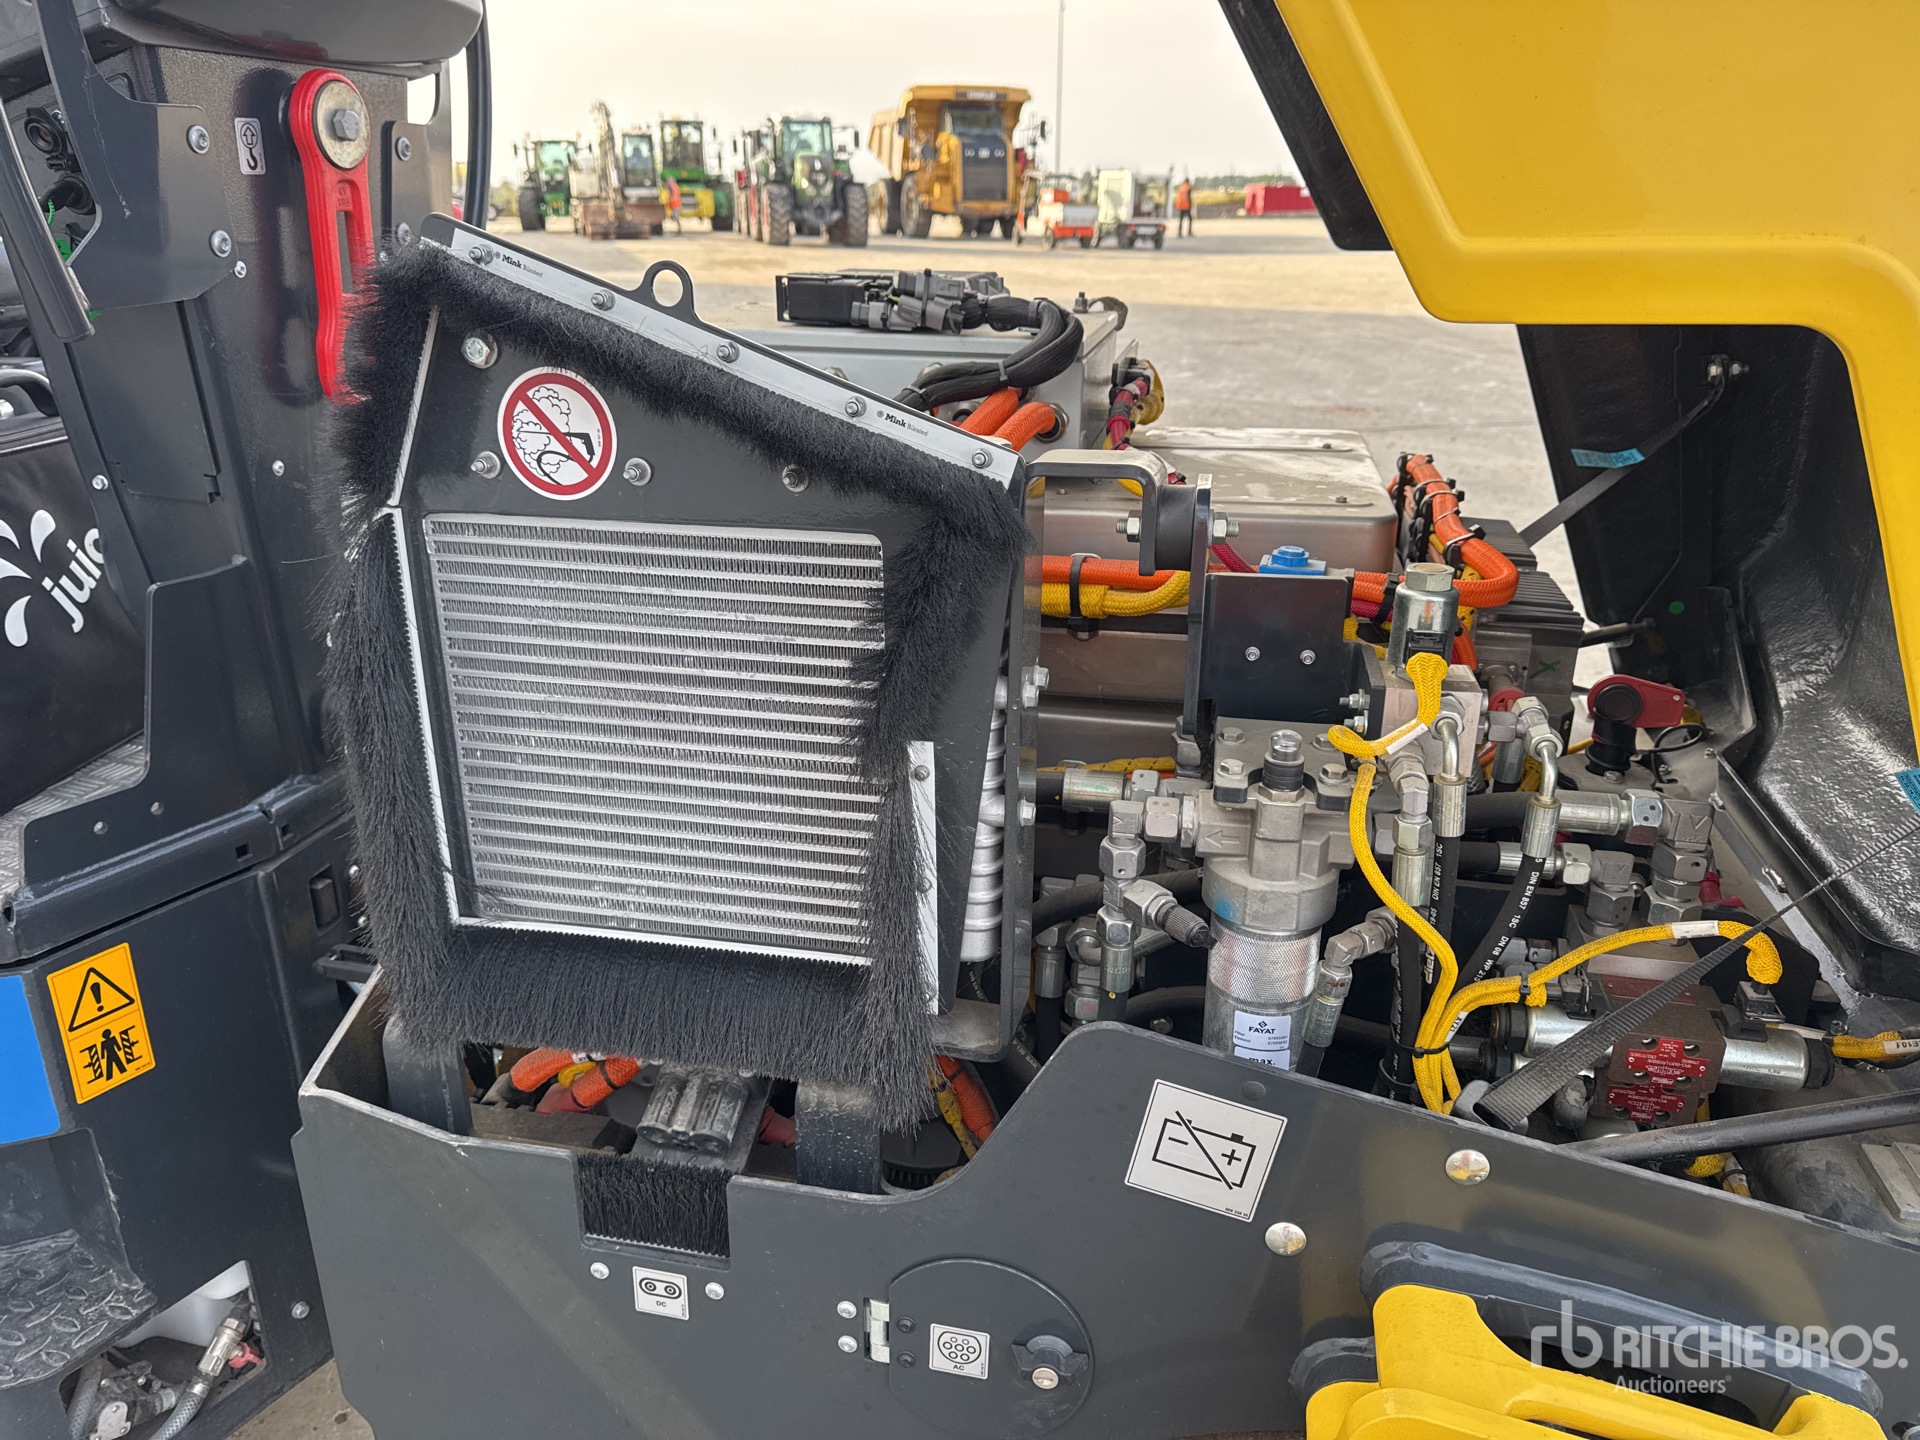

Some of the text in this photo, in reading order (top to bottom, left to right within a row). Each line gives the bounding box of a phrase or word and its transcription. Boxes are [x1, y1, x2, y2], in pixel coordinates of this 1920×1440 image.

[502, 254, 522, 268] Mink
[885, 413, 906, 427] Mink
[1434, 876, 1440, 887] EN
[1530, 872, 1540, 884] DIN
[1525, 886, 1534, 896] EN
[1518, 896, 1530, 910] 857
[1508, 914, 1521, 929] 1SC
[1498, 936, 1510, 947] DN
[1492, 946, 1502, 956] 08
[1484, 958, 1494, 971] WP
